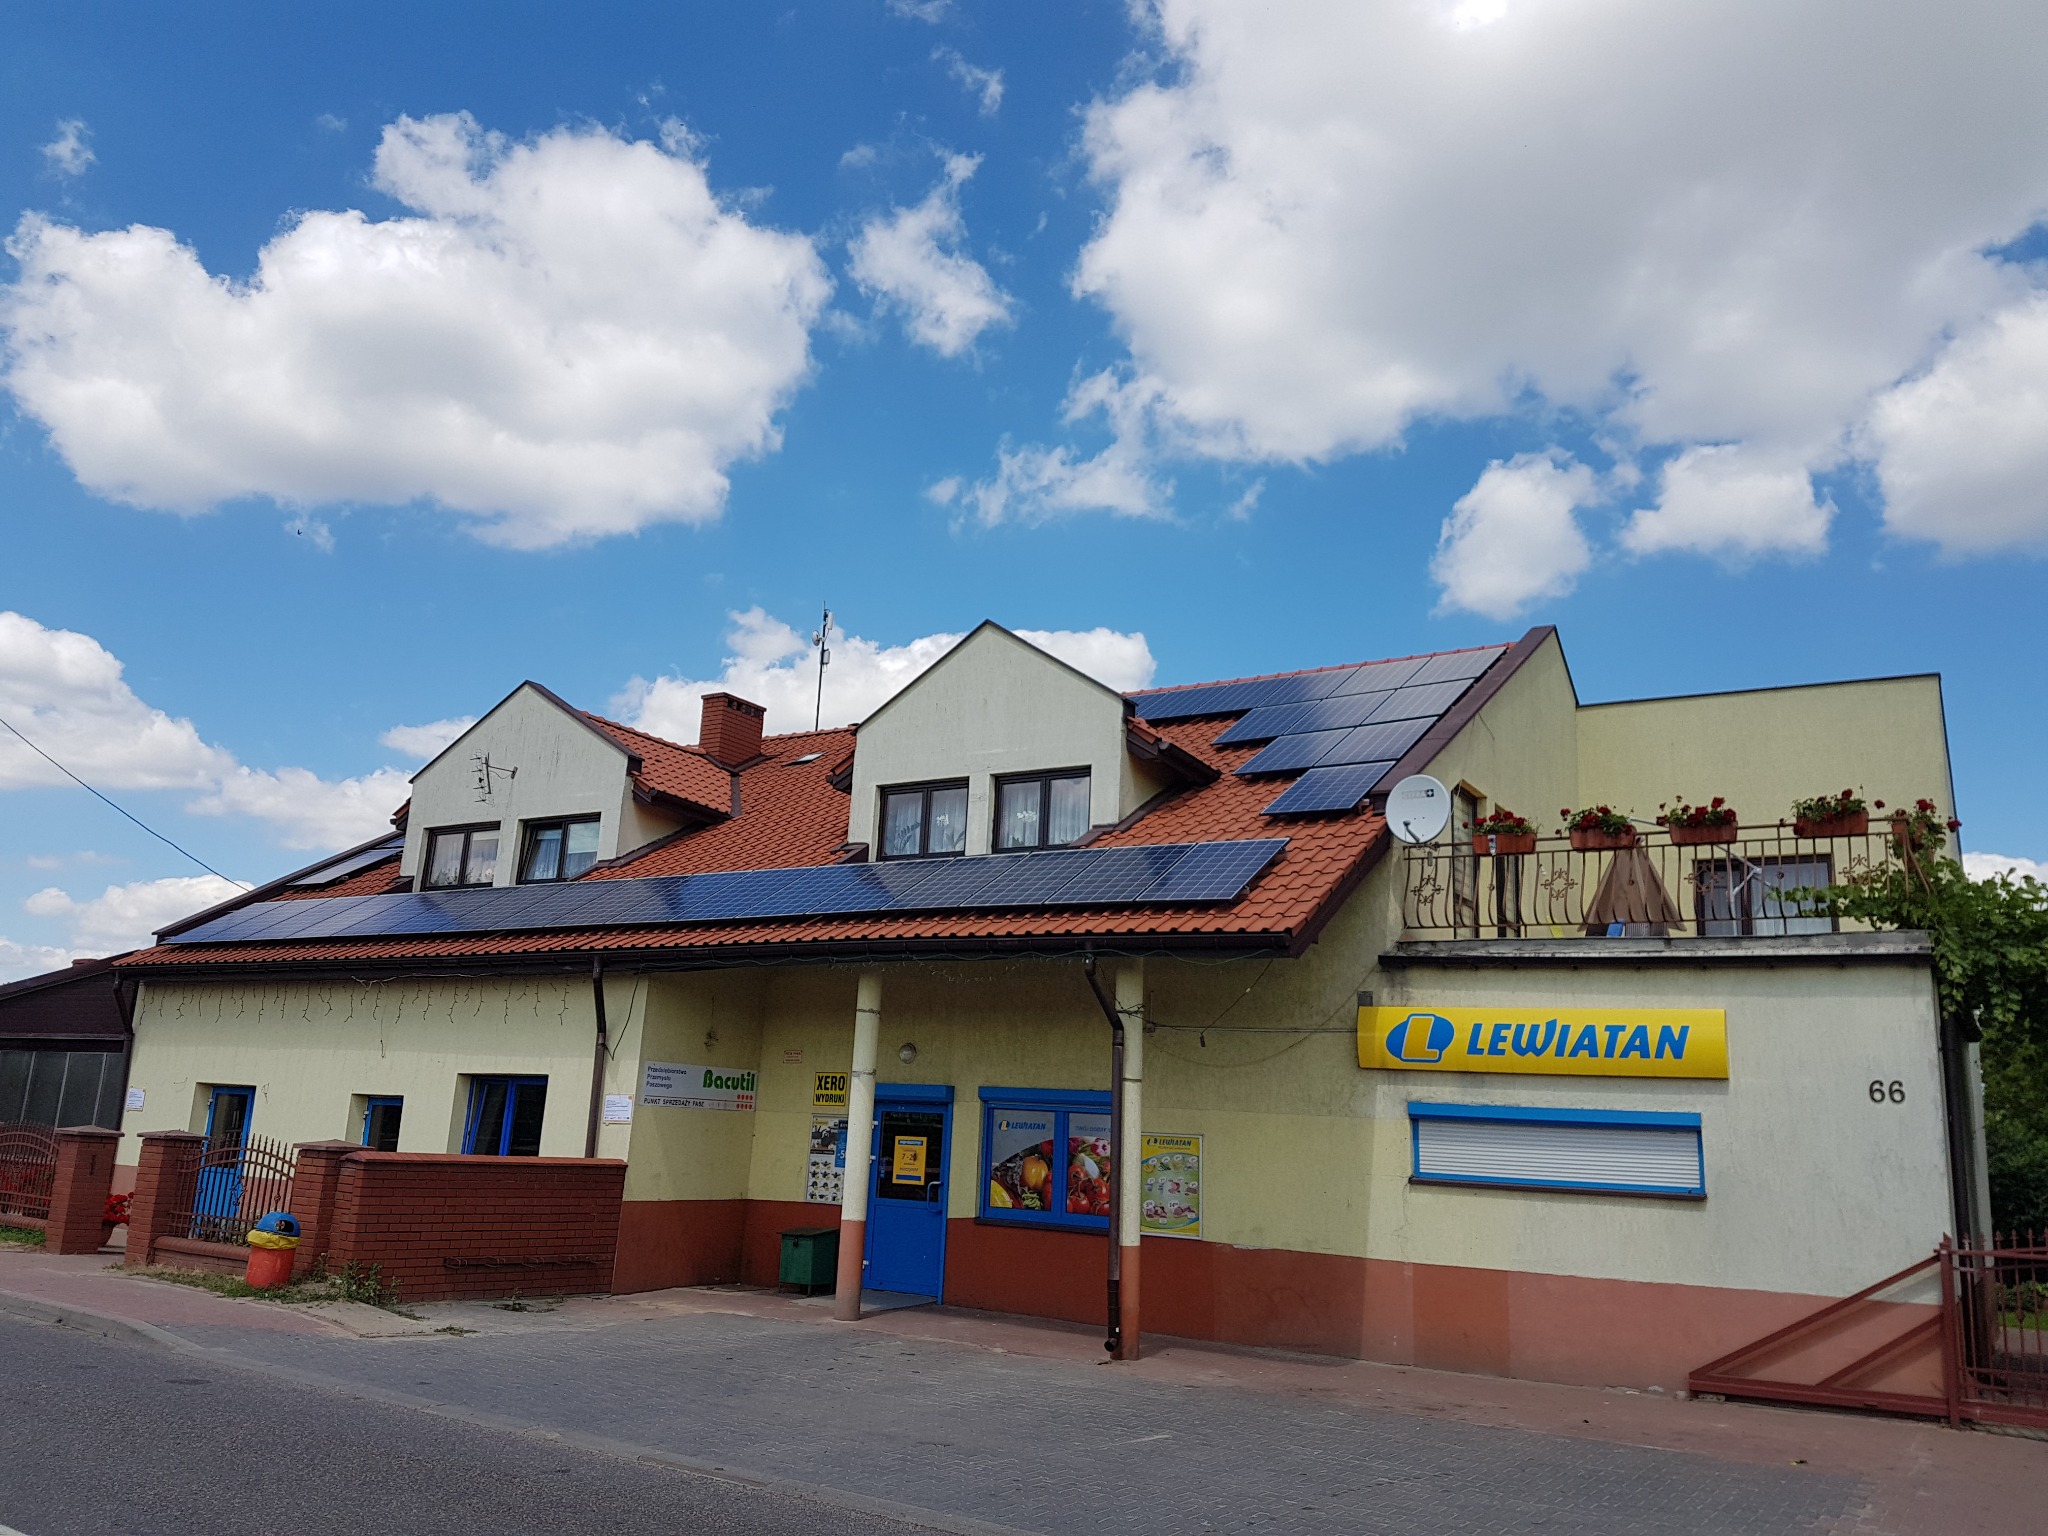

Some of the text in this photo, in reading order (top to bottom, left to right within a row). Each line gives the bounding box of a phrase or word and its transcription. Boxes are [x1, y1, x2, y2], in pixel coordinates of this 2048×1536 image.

[1466, 1018, 1690, 1060] LEWIATAN
[646, 1081, 672, 1089] Paszowego
[703, 1069, 755, 1091] Bacutil
[816, 1075, 846, 1091] XERO
[1869, 1079, 1906, 1103] 66
[662, 1098, 691, 1107] SPRZEDAŻY
[815, 1093, 845, 1103] WYDRUKI
[1011, 1121, 1047, 1131] LEWIATAN
